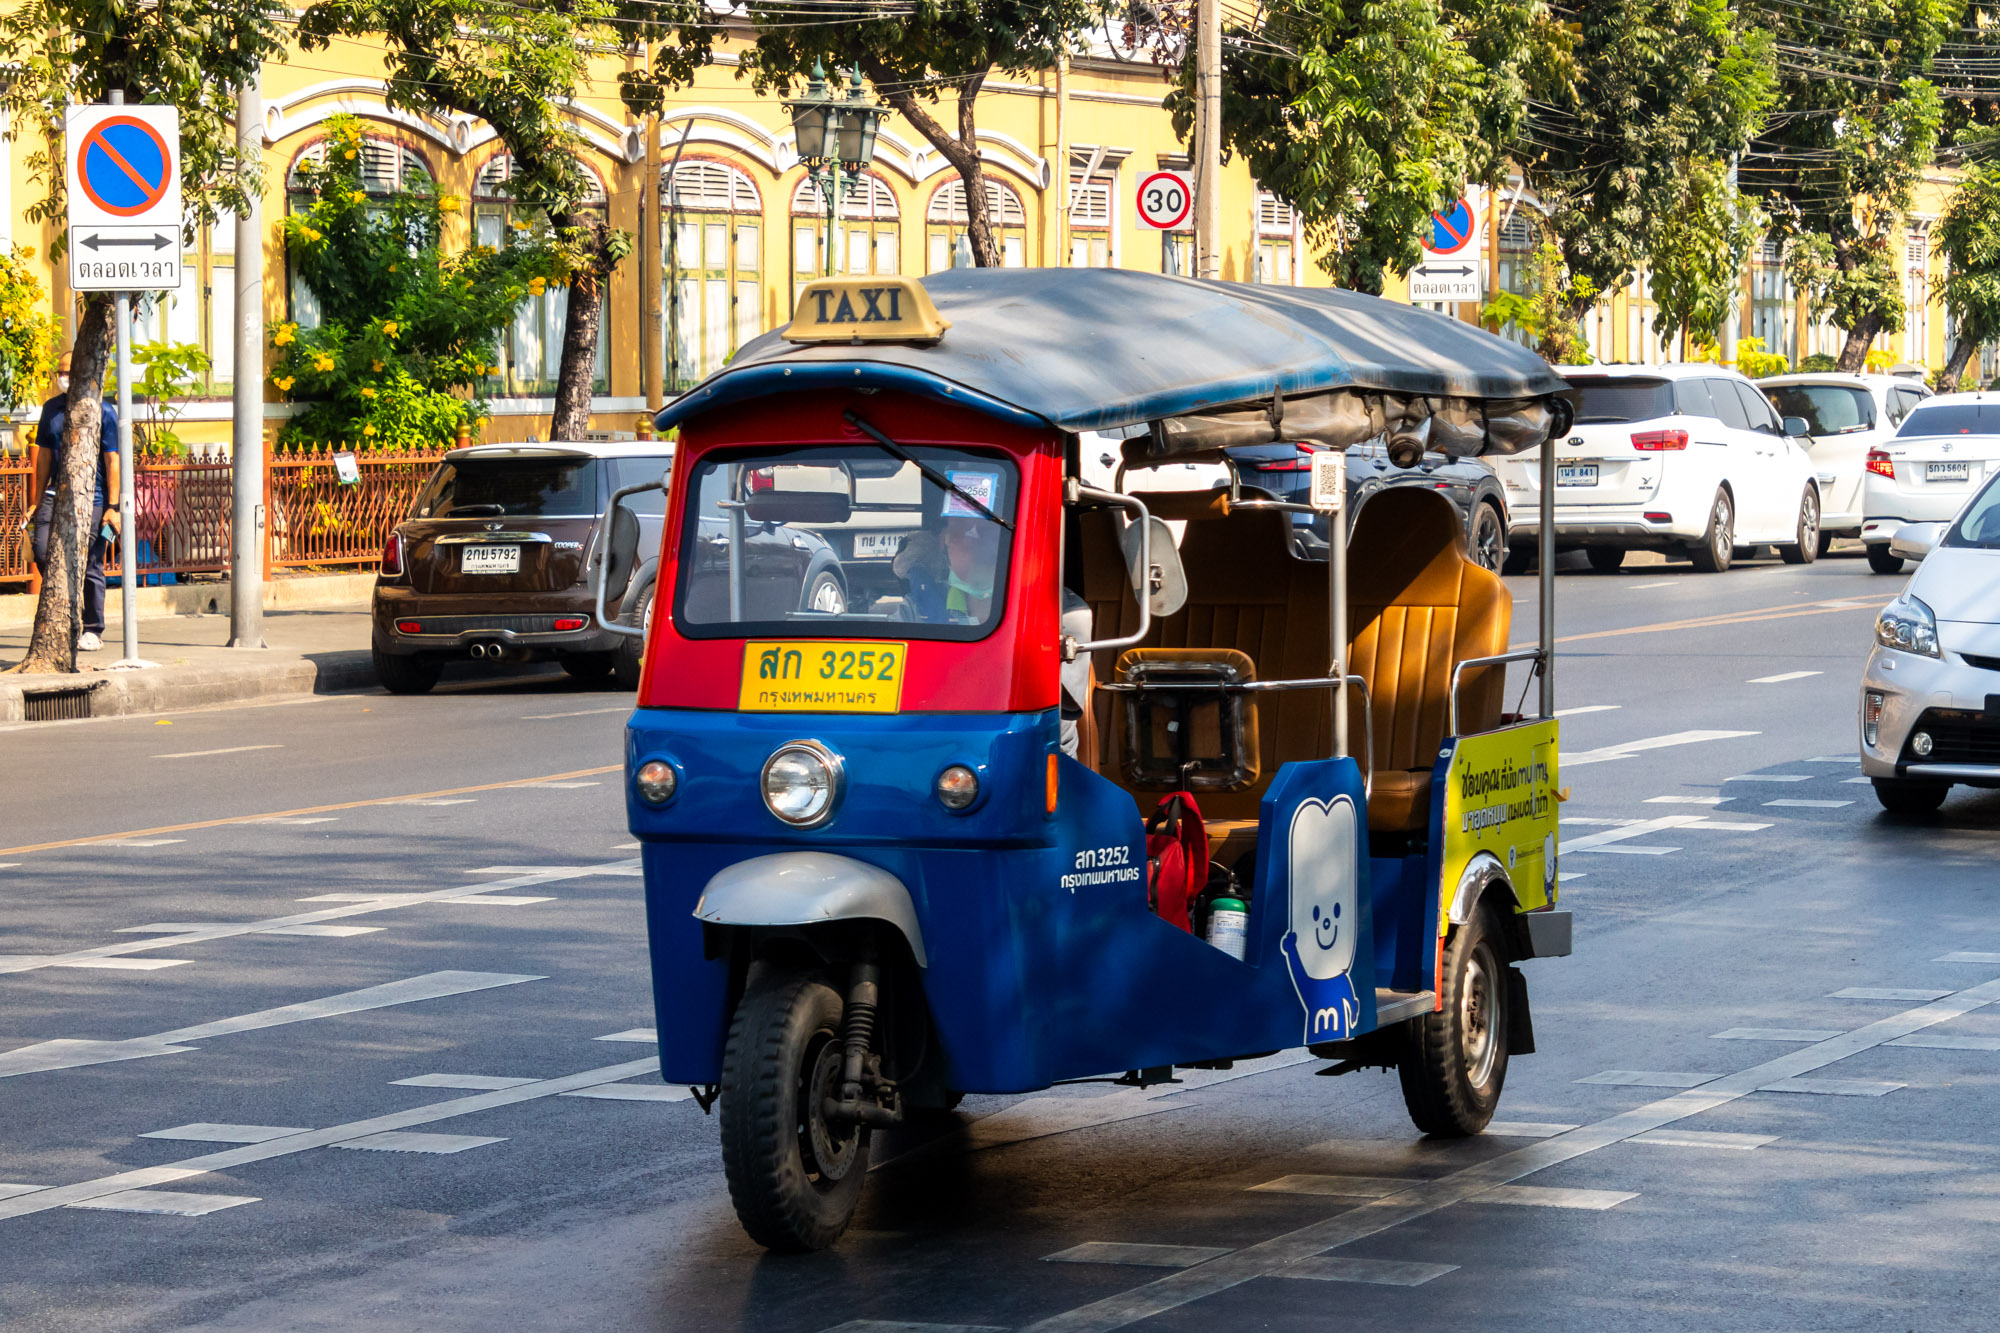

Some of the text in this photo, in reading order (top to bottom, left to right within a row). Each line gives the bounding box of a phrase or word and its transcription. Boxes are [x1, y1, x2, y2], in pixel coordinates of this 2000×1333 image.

[1146, 188, 1182, 213] 30
[79, 261, 174, 278] ตลอดเวลา
[1413, 283, 1476, 294] ตลอดเวลา
[809, 287, 902, 323] TAXI
[967, 486, 989, 497] 2568
[466, 548, 517, 560] 2กย 5792
[554, 541, 580, 549] COOPER
[759, 646, 896, 681] สก 3252
[758, 690, 878, 708] กรุงเทพมหานคร
[1075, 845, 1129, 870] สก 3252
[1060, 866, 1140, 894] กรุงเทพมหานคร
